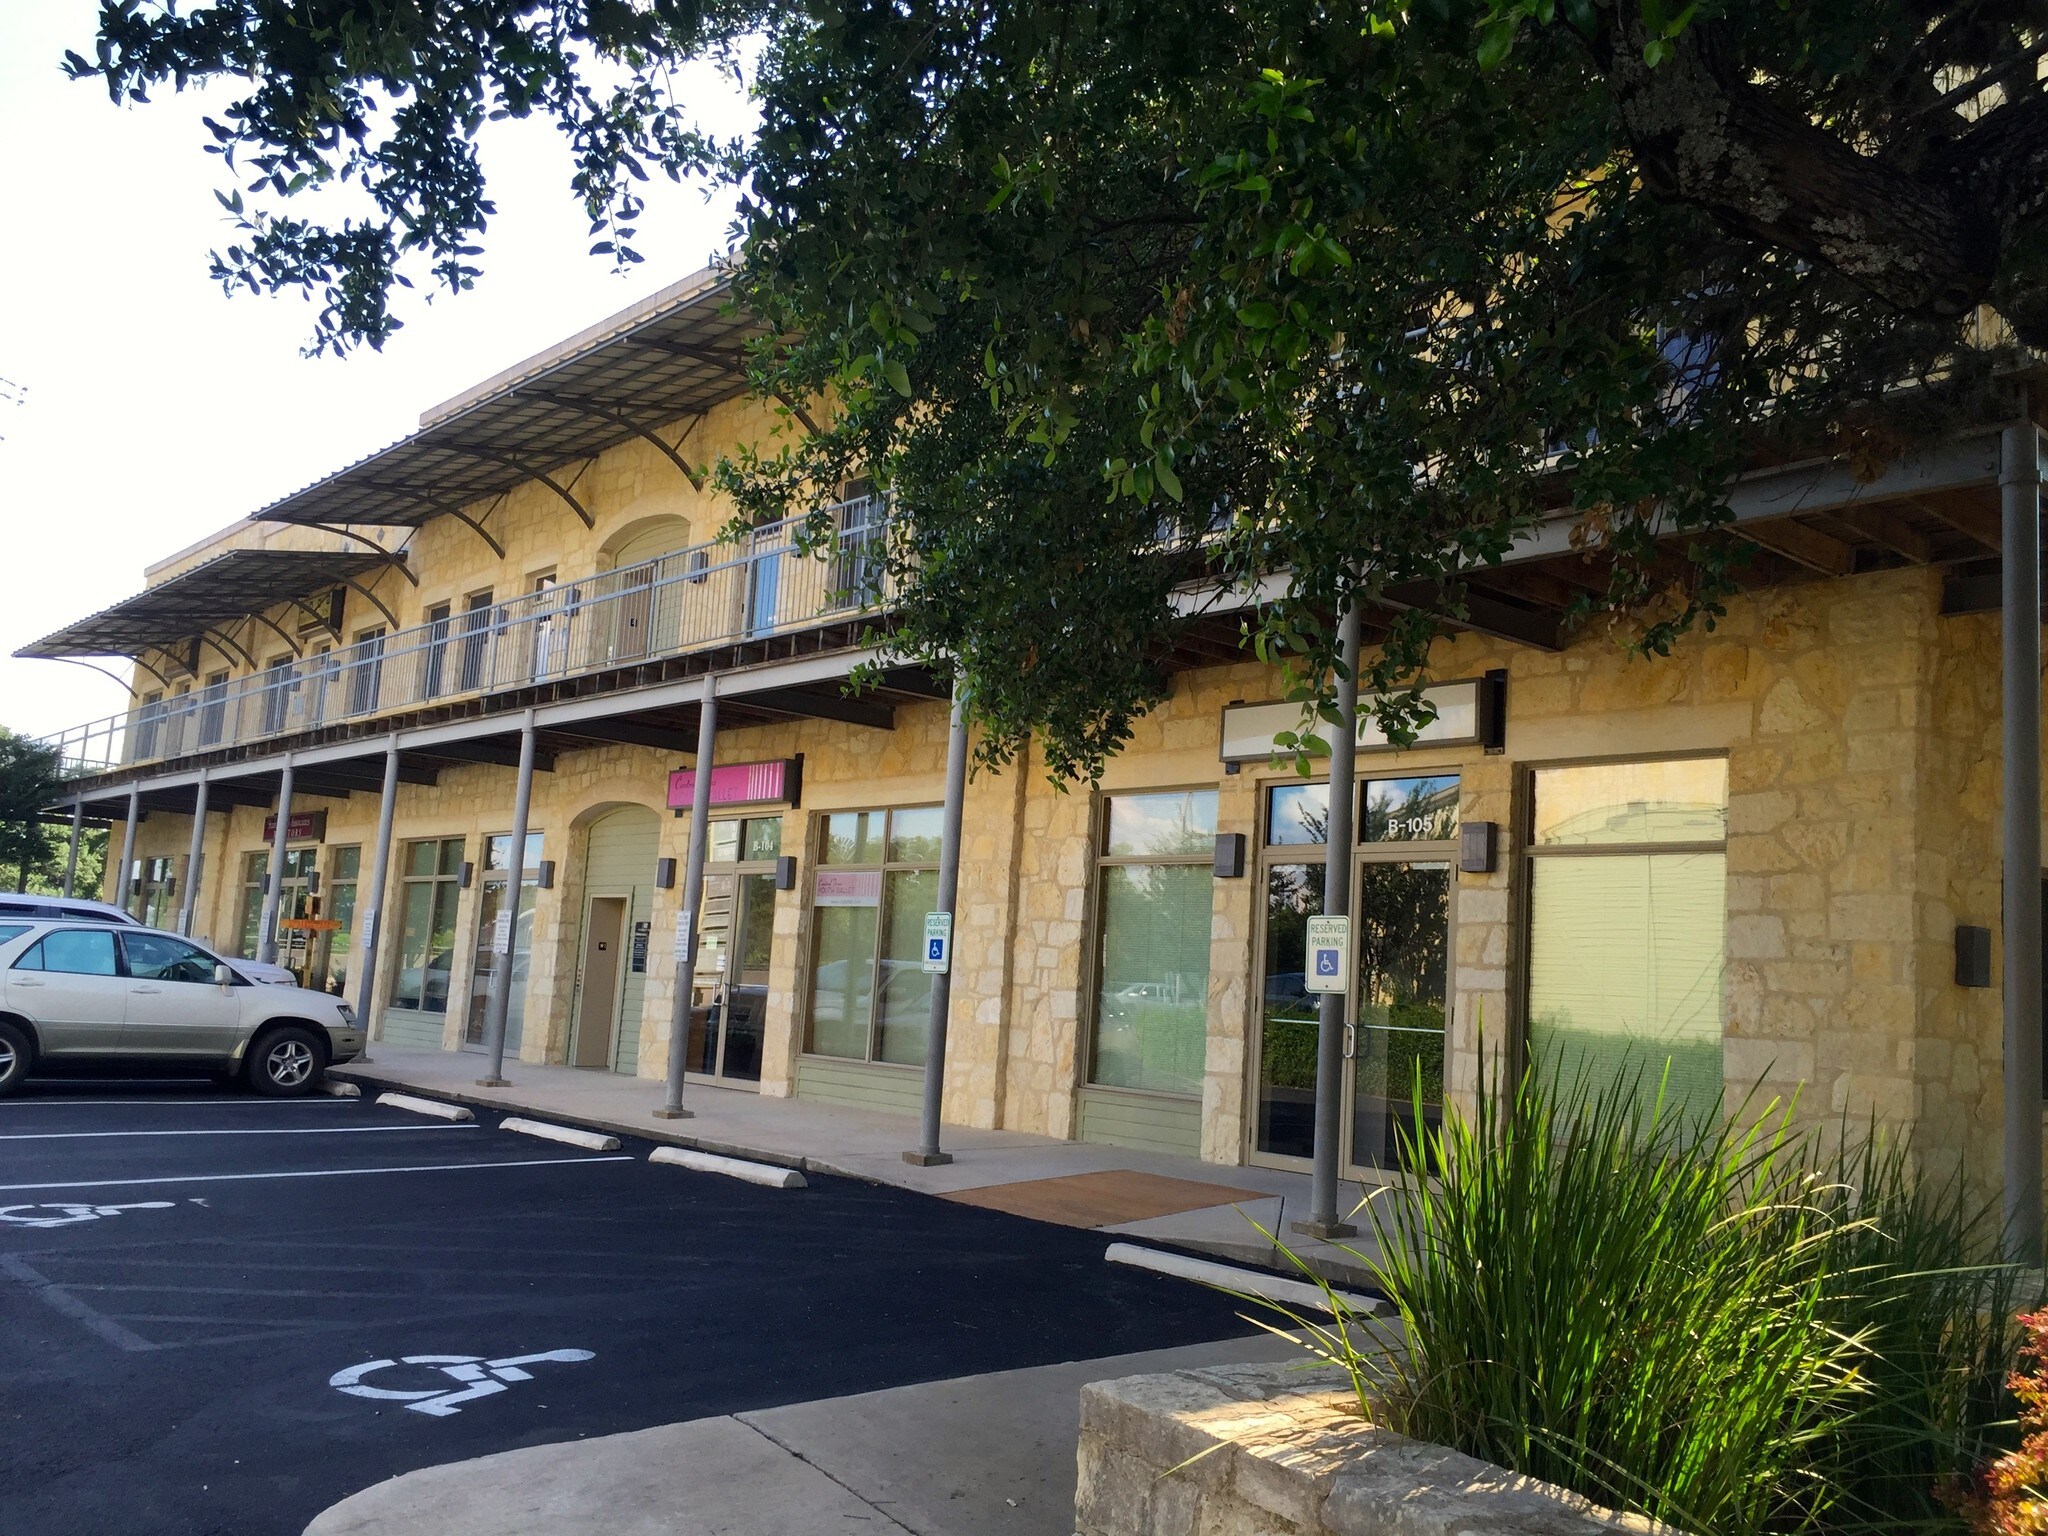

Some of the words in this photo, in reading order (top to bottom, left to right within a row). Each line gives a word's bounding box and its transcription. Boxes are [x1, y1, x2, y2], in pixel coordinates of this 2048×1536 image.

[675, 775, 697, 791] Centr
[1388, 812, 1434, 834] B-105
[753, 840, 774, 851] B-104
[927, 918, 950, 927] RESERVED
[927, 928, 947, 937] PARKING
[1310, 923, 1347, 934] RESERVED
[1311, 936, 1344, 947] PARKING
